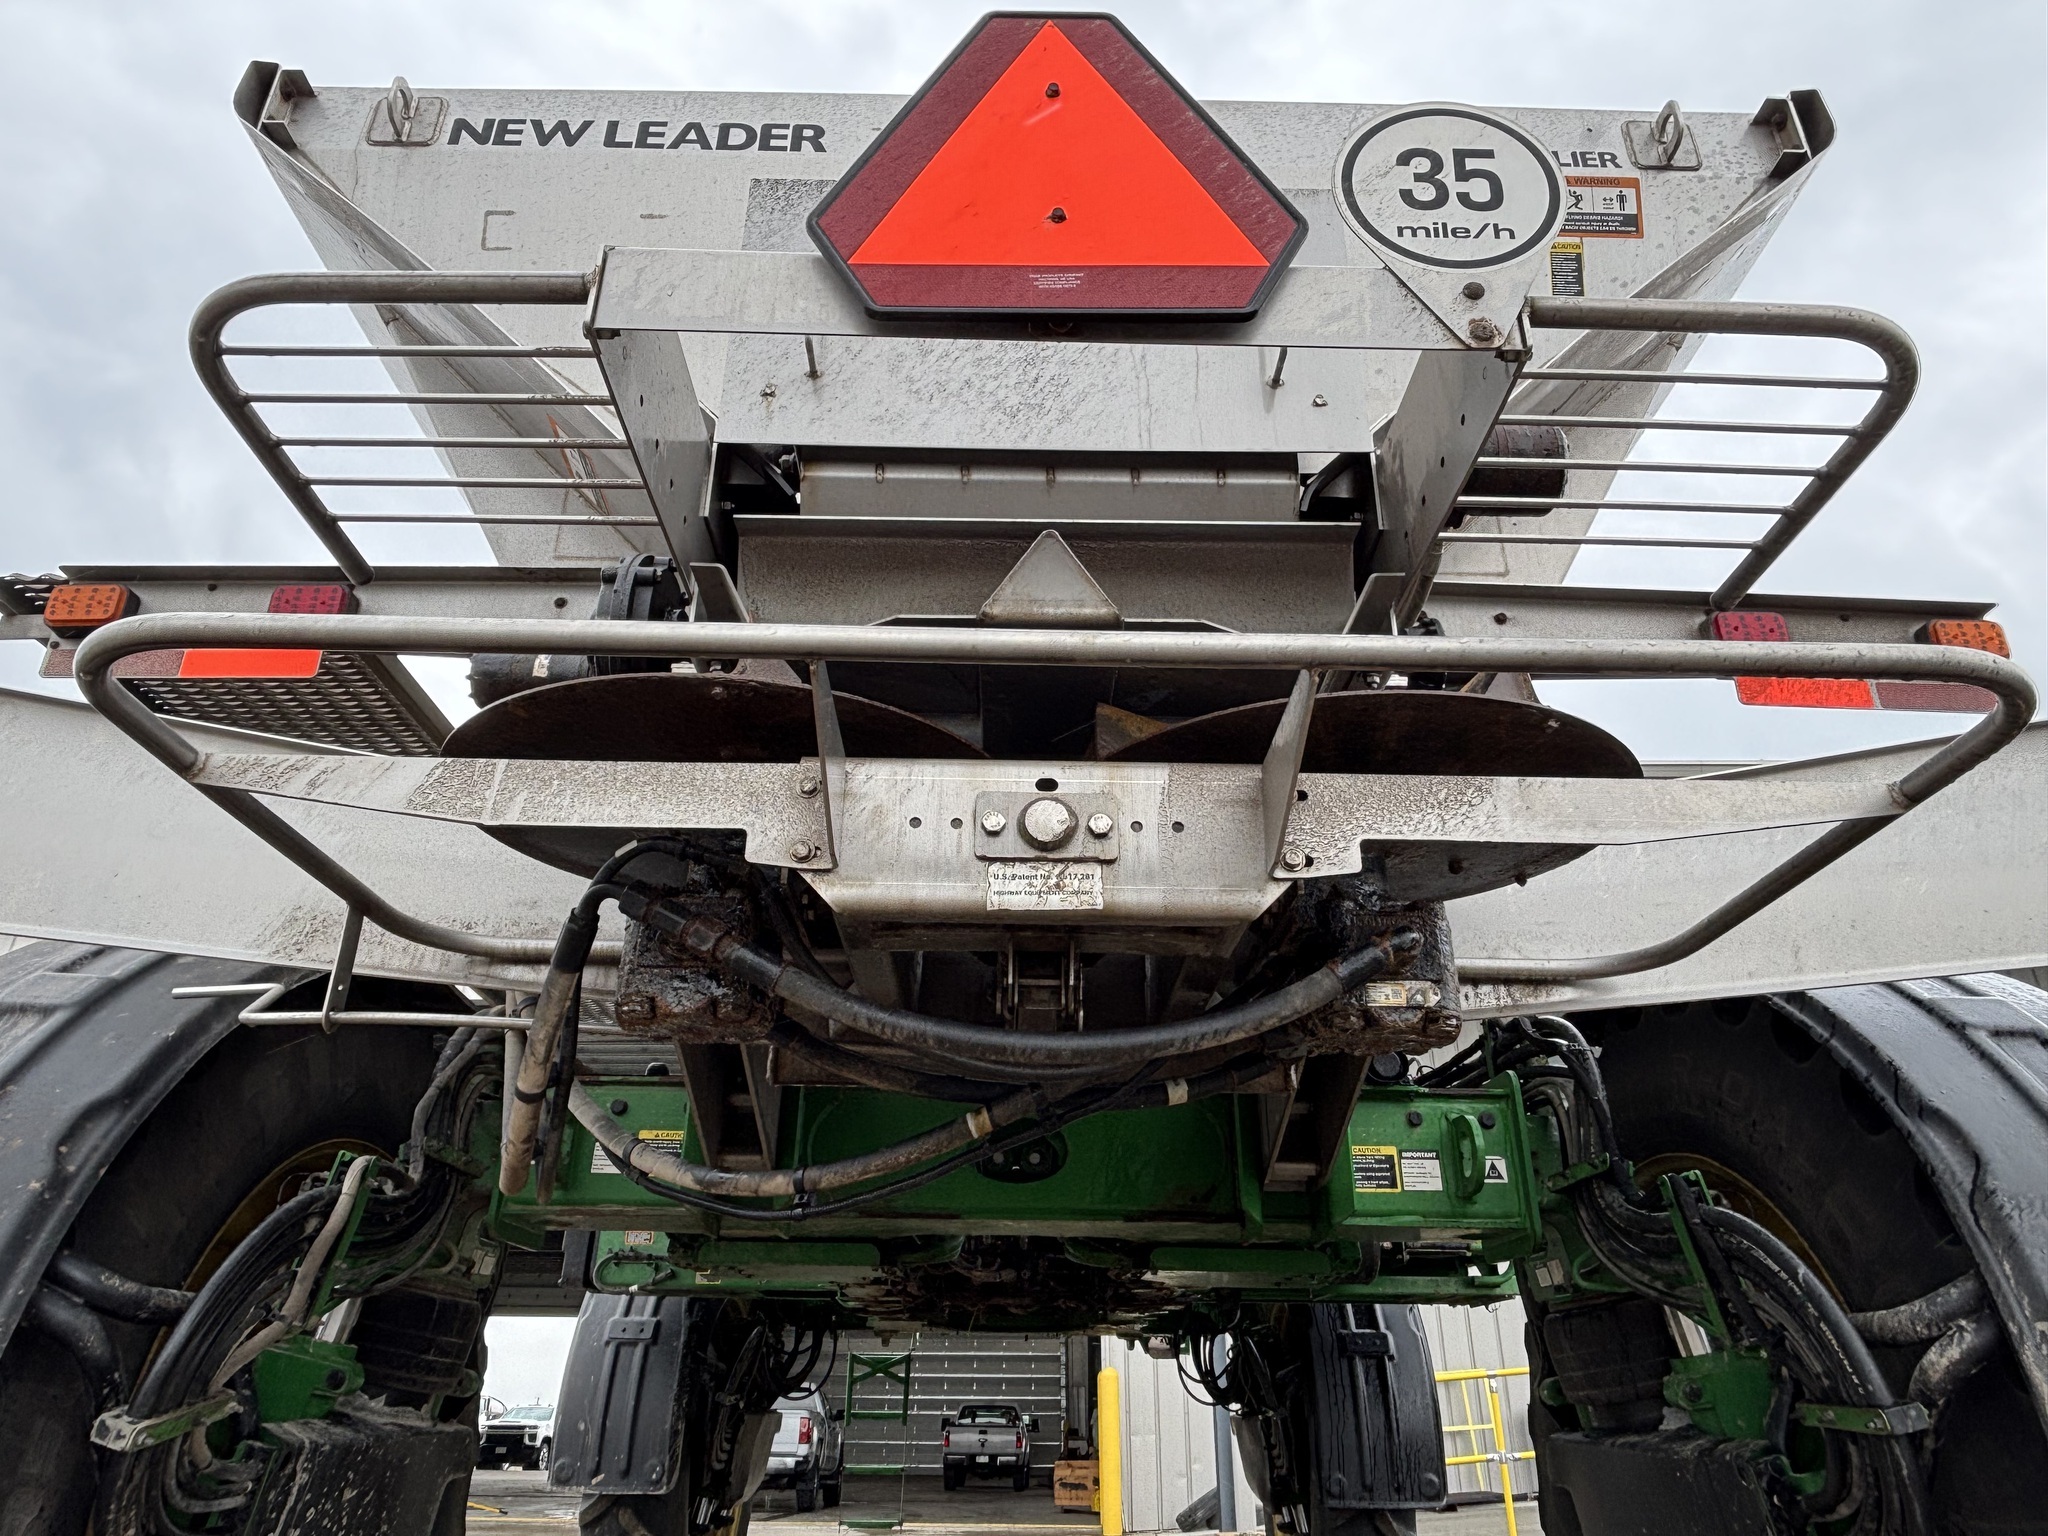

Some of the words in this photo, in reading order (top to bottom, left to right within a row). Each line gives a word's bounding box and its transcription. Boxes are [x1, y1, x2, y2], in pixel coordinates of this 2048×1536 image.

[447, 117, 595, 147] NEW
[603, 120, 827, 153] LEADER
[1551, 150, 1623, 169] LIER
[1395, 147, 1504, 212] 35
[1573, 177, 1621, 186] WARNING
[1397, 221, 1516, 240] mile/h
